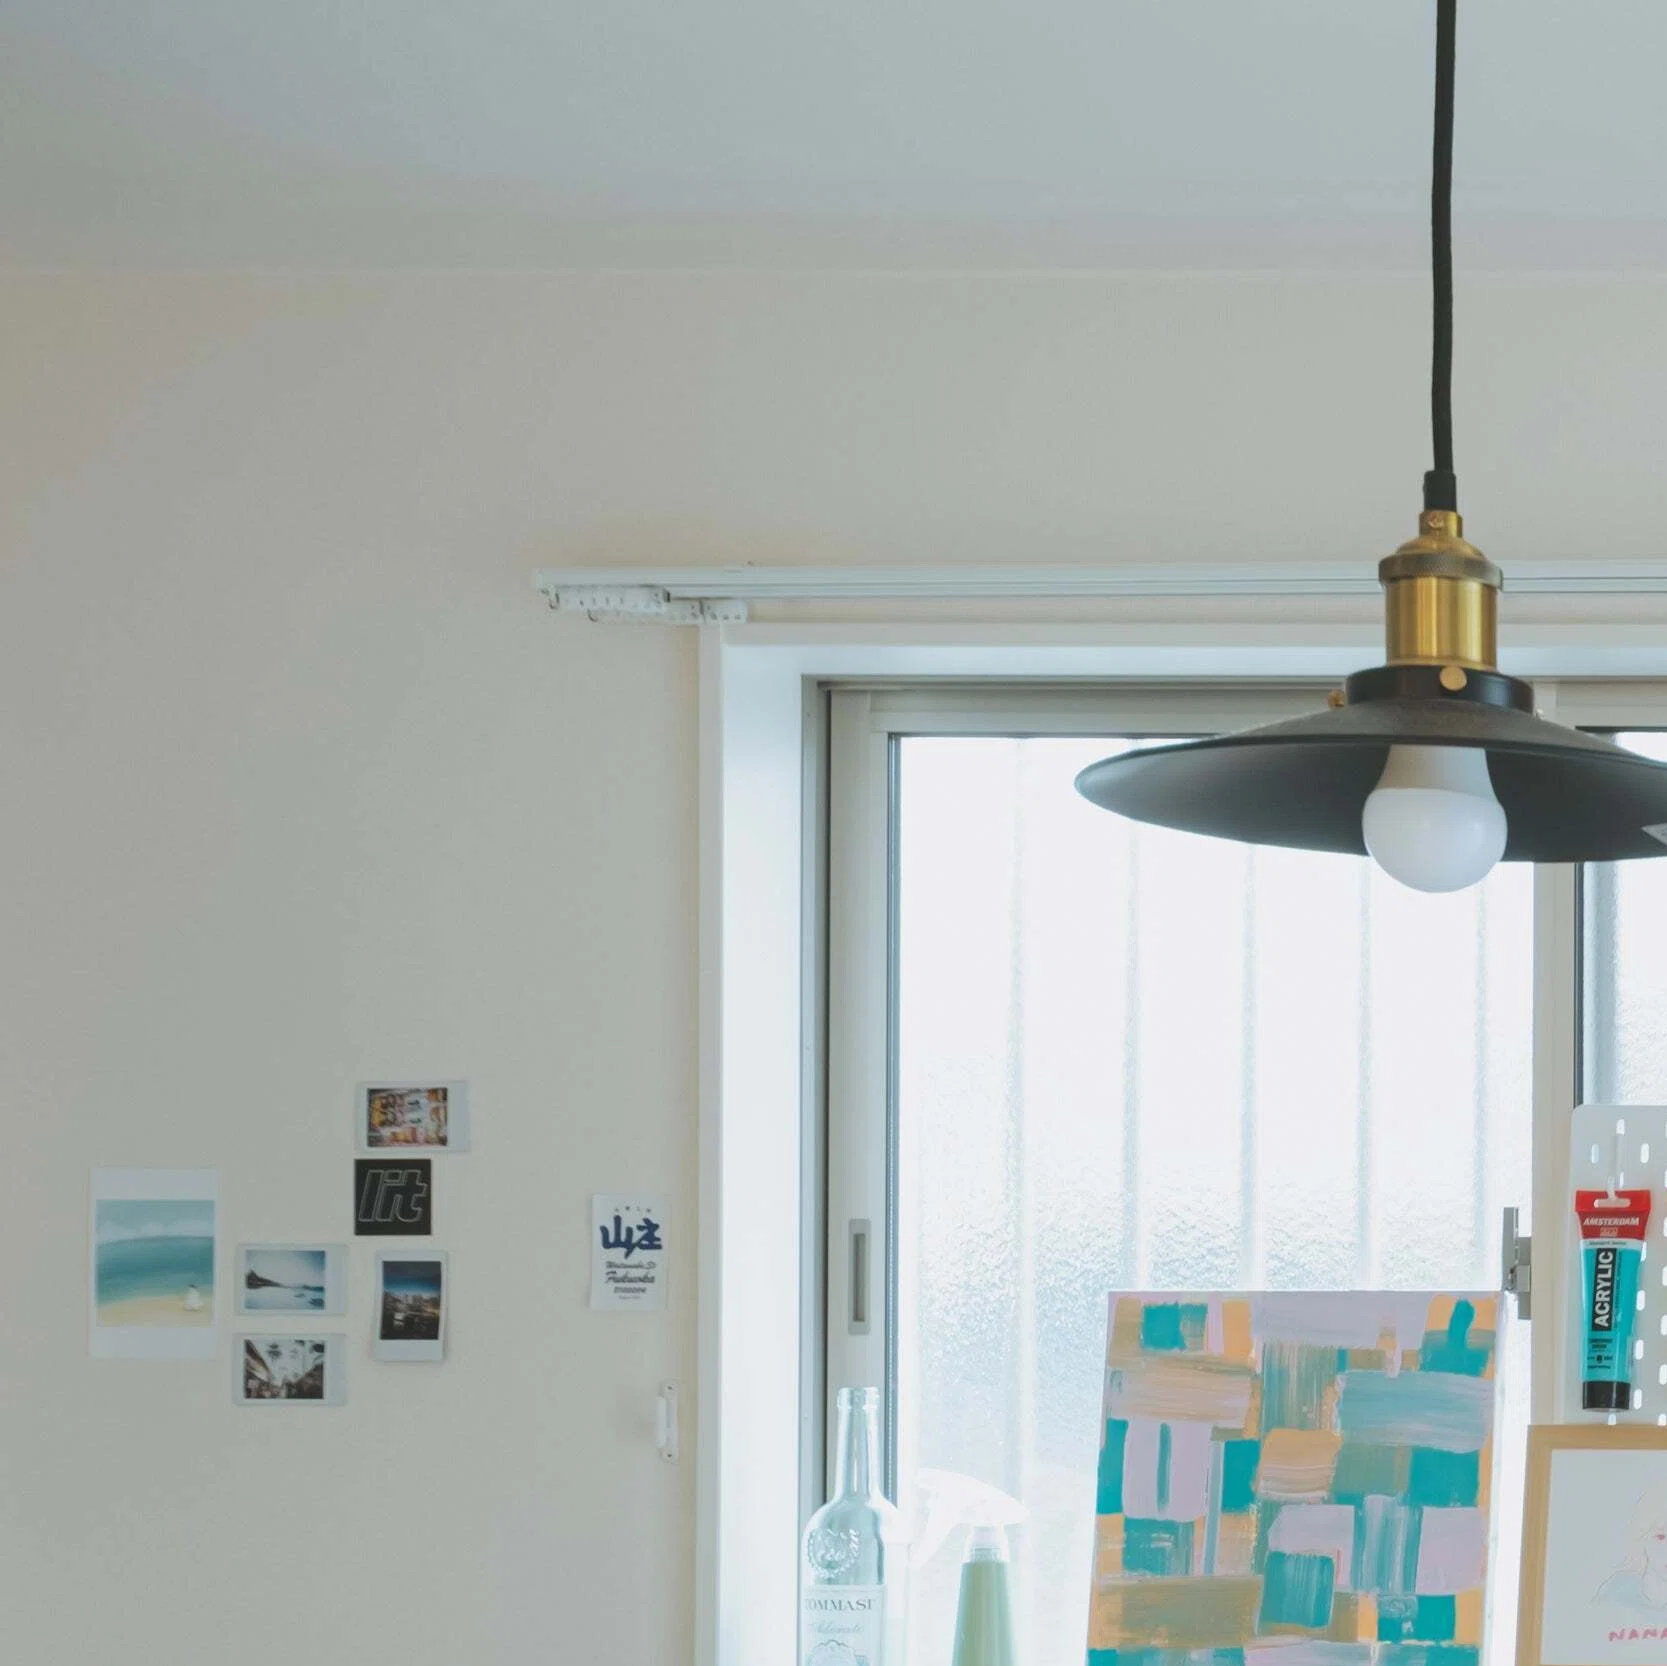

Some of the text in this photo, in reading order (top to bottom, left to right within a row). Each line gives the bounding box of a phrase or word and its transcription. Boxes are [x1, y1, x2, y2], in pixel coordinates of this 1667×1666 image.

[358, 1169, 428, 1223] lit
[1583, 1217, 1640, 1226] AMSTERDAM
[1593, 1251, 1614, 1328] ACRYLIC
